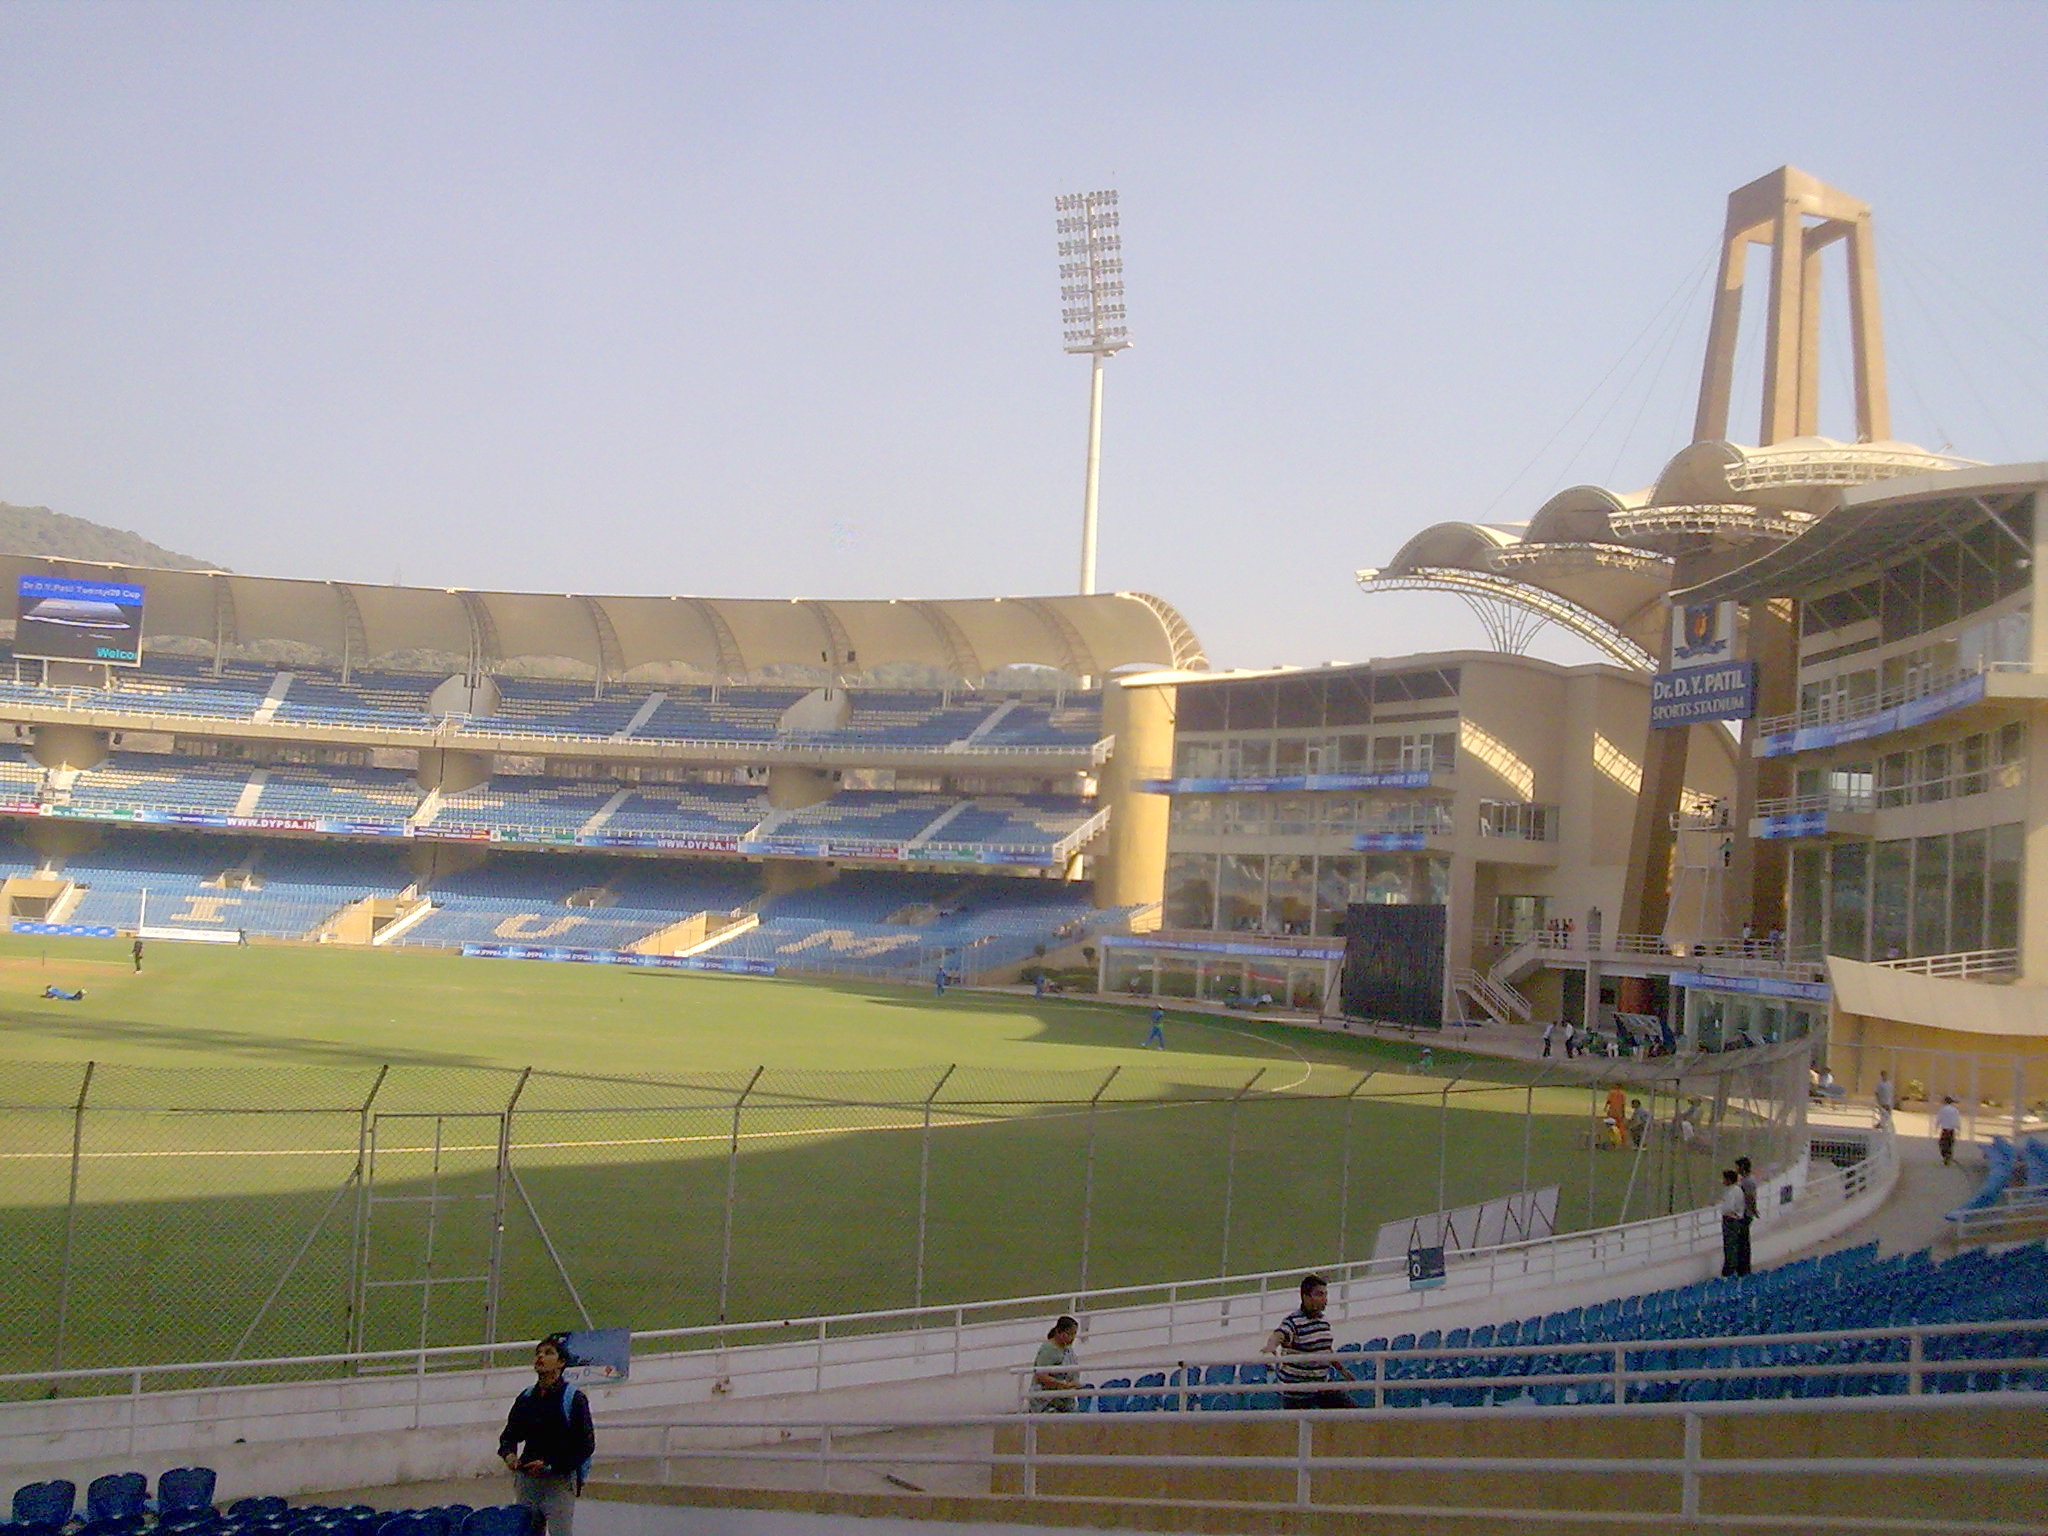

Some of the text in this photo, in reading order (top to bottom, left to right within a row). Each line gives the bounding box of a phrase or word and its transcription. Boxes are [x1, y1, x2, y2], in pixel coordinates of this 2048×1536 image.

[123, 590, 140, 600] Cup
[1705, 670, 1746, 693] PATIL
[1653, 696, 1745, 720] SPORTS STADIUM
[227, 817, 316, 830] WWW.DYPSA.IN
[658, 839, 737, 852] WWW.DYPSA.IN
